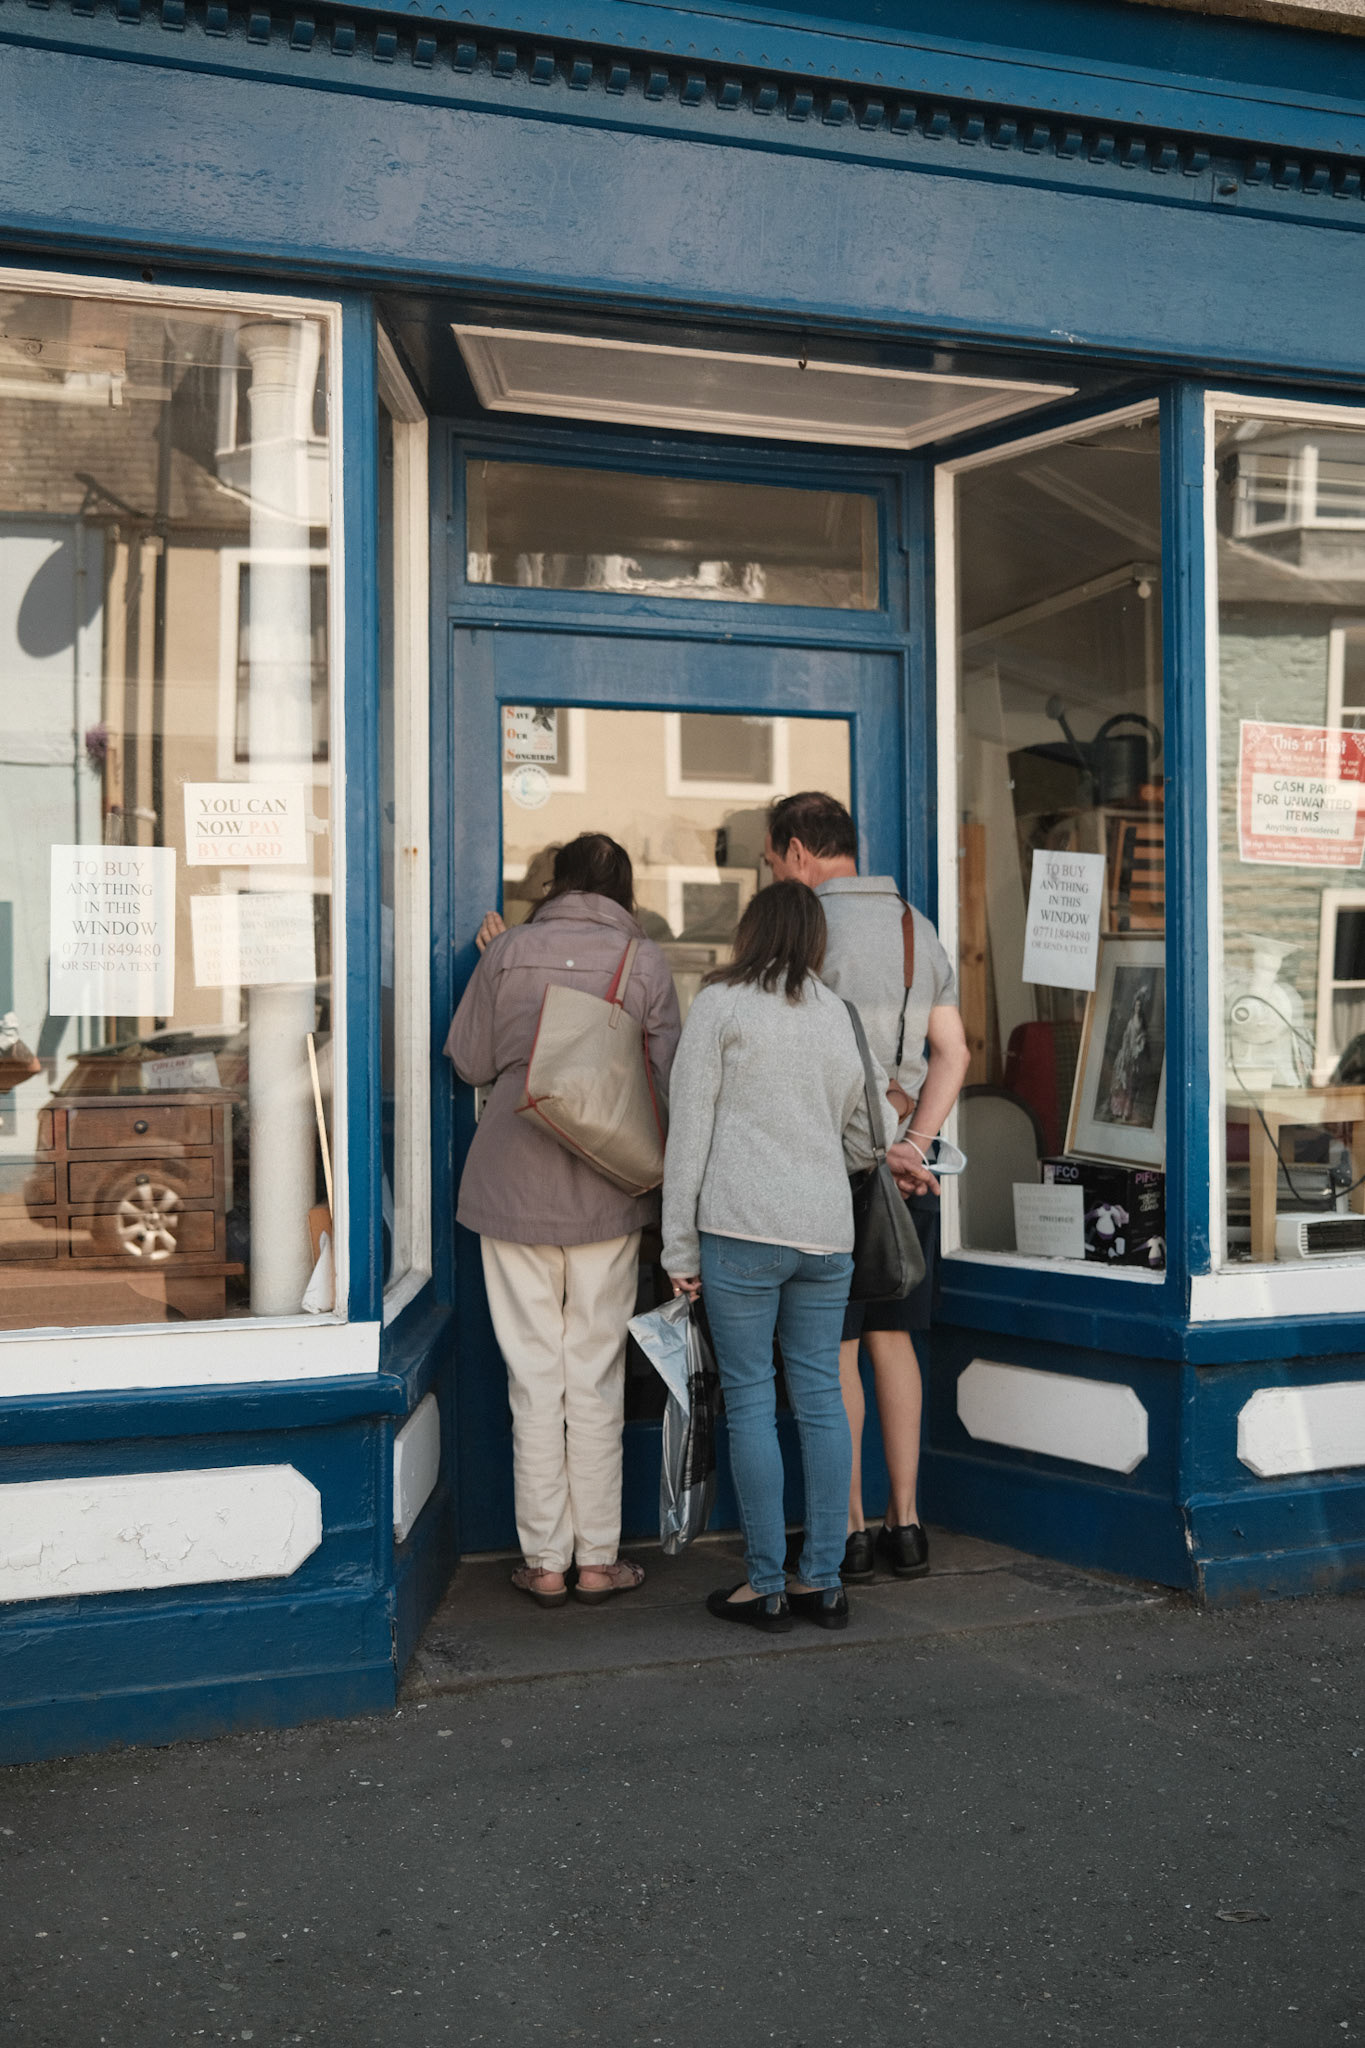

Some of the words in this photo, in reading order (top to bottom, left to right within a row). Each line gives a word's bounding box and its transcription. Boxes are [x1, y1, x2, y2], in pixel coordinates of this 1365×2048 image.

[507, 728, 528, 740] OUR
[1271, 734, 1299, 750] This
[507, 749, 555, 761] SONGBIRDS
[1273, 781, 1305, 792] CASH
[1309, 783, 1336, 794] PAID
[200, 799, 241, 813] YOU
[247, 799, 288, 813] CAN
[1257, 794, 1279, 805] FOR
[1283, 795, 1352, 810] UNWANTED
[1285, 810, 1320, 822] ITEMS
[196, 821, 243, 835] NOW
[249, 821, 282, 835] PAY
[1265, 823, 1298, 834] Anything
[1300, 825, 1340, 835] considered
[197, 842, 220, 856] BY
[227, 842, 282, 856] CARD
[73, 860, 98, 876] TO
[104, 861, 145, 877] BUY
[1046, 863, 1060, 876] TO
[1062, 864, 1086, 878] BUY
[66, 882, 153, 896] ANYTHING
[1040, 880, 1089, 894] ANYTHING
[84, 901, 100, 914] IN
[105, 901, 141, 914] THIS
[1048, 895, 1058, 905] IN
[1061, 896, 1081, 908] THIS
[1040, 909, 1090, 926] WINDOW
[72, 920, 159, 936] WINDOW
[62, 942, 161, 957] 07711849480
[1043, 942, 1062, 952] SEND
[1070, 945, 1088, 955] TEXT
[61, 960, 79, 971] OR
[82, 960, 115, 971] SEND
[118, 961, 126, 972] A
[128, 961, 160, 972] TEXT
